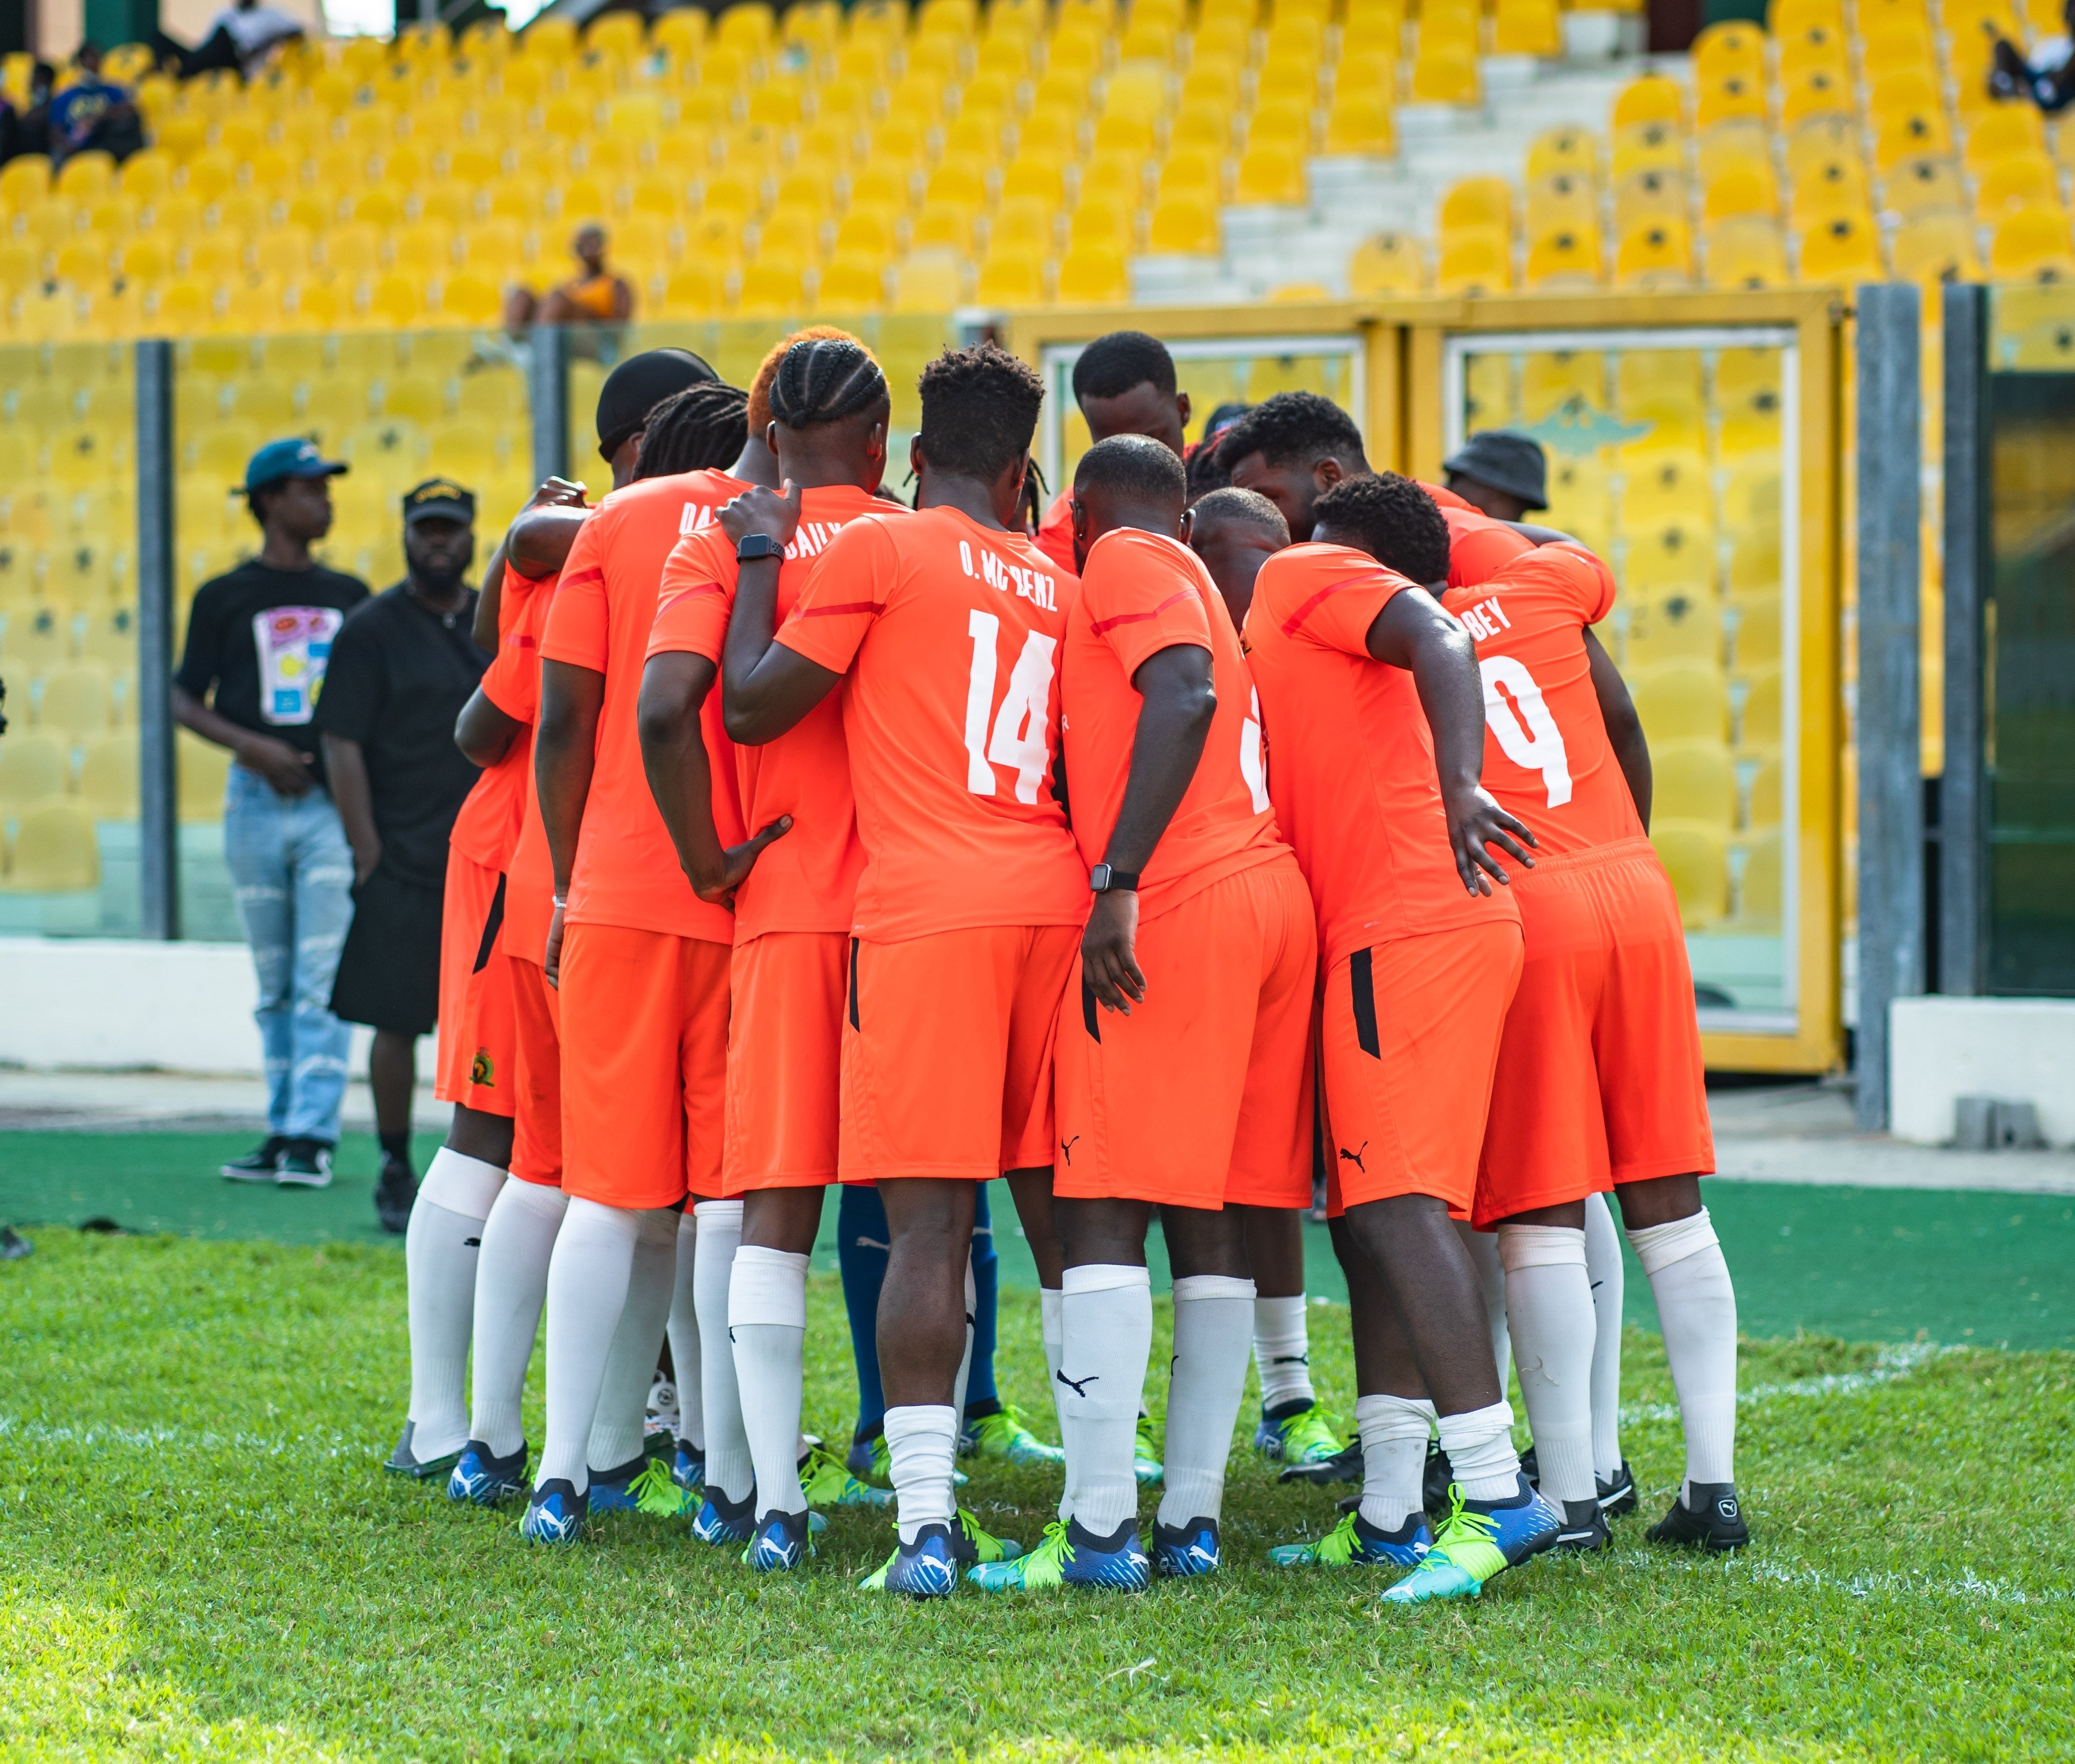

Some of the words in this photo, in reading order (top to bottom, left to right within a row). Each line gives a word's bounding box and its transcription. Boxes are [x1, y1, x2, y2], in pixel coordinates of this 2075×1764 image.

[678, 502, 714, 534] DA
[1457, 596, 1512, 642] BEY
[964, 608, 1058, 806] 14
[1479, 655, 1573, 810] 9
